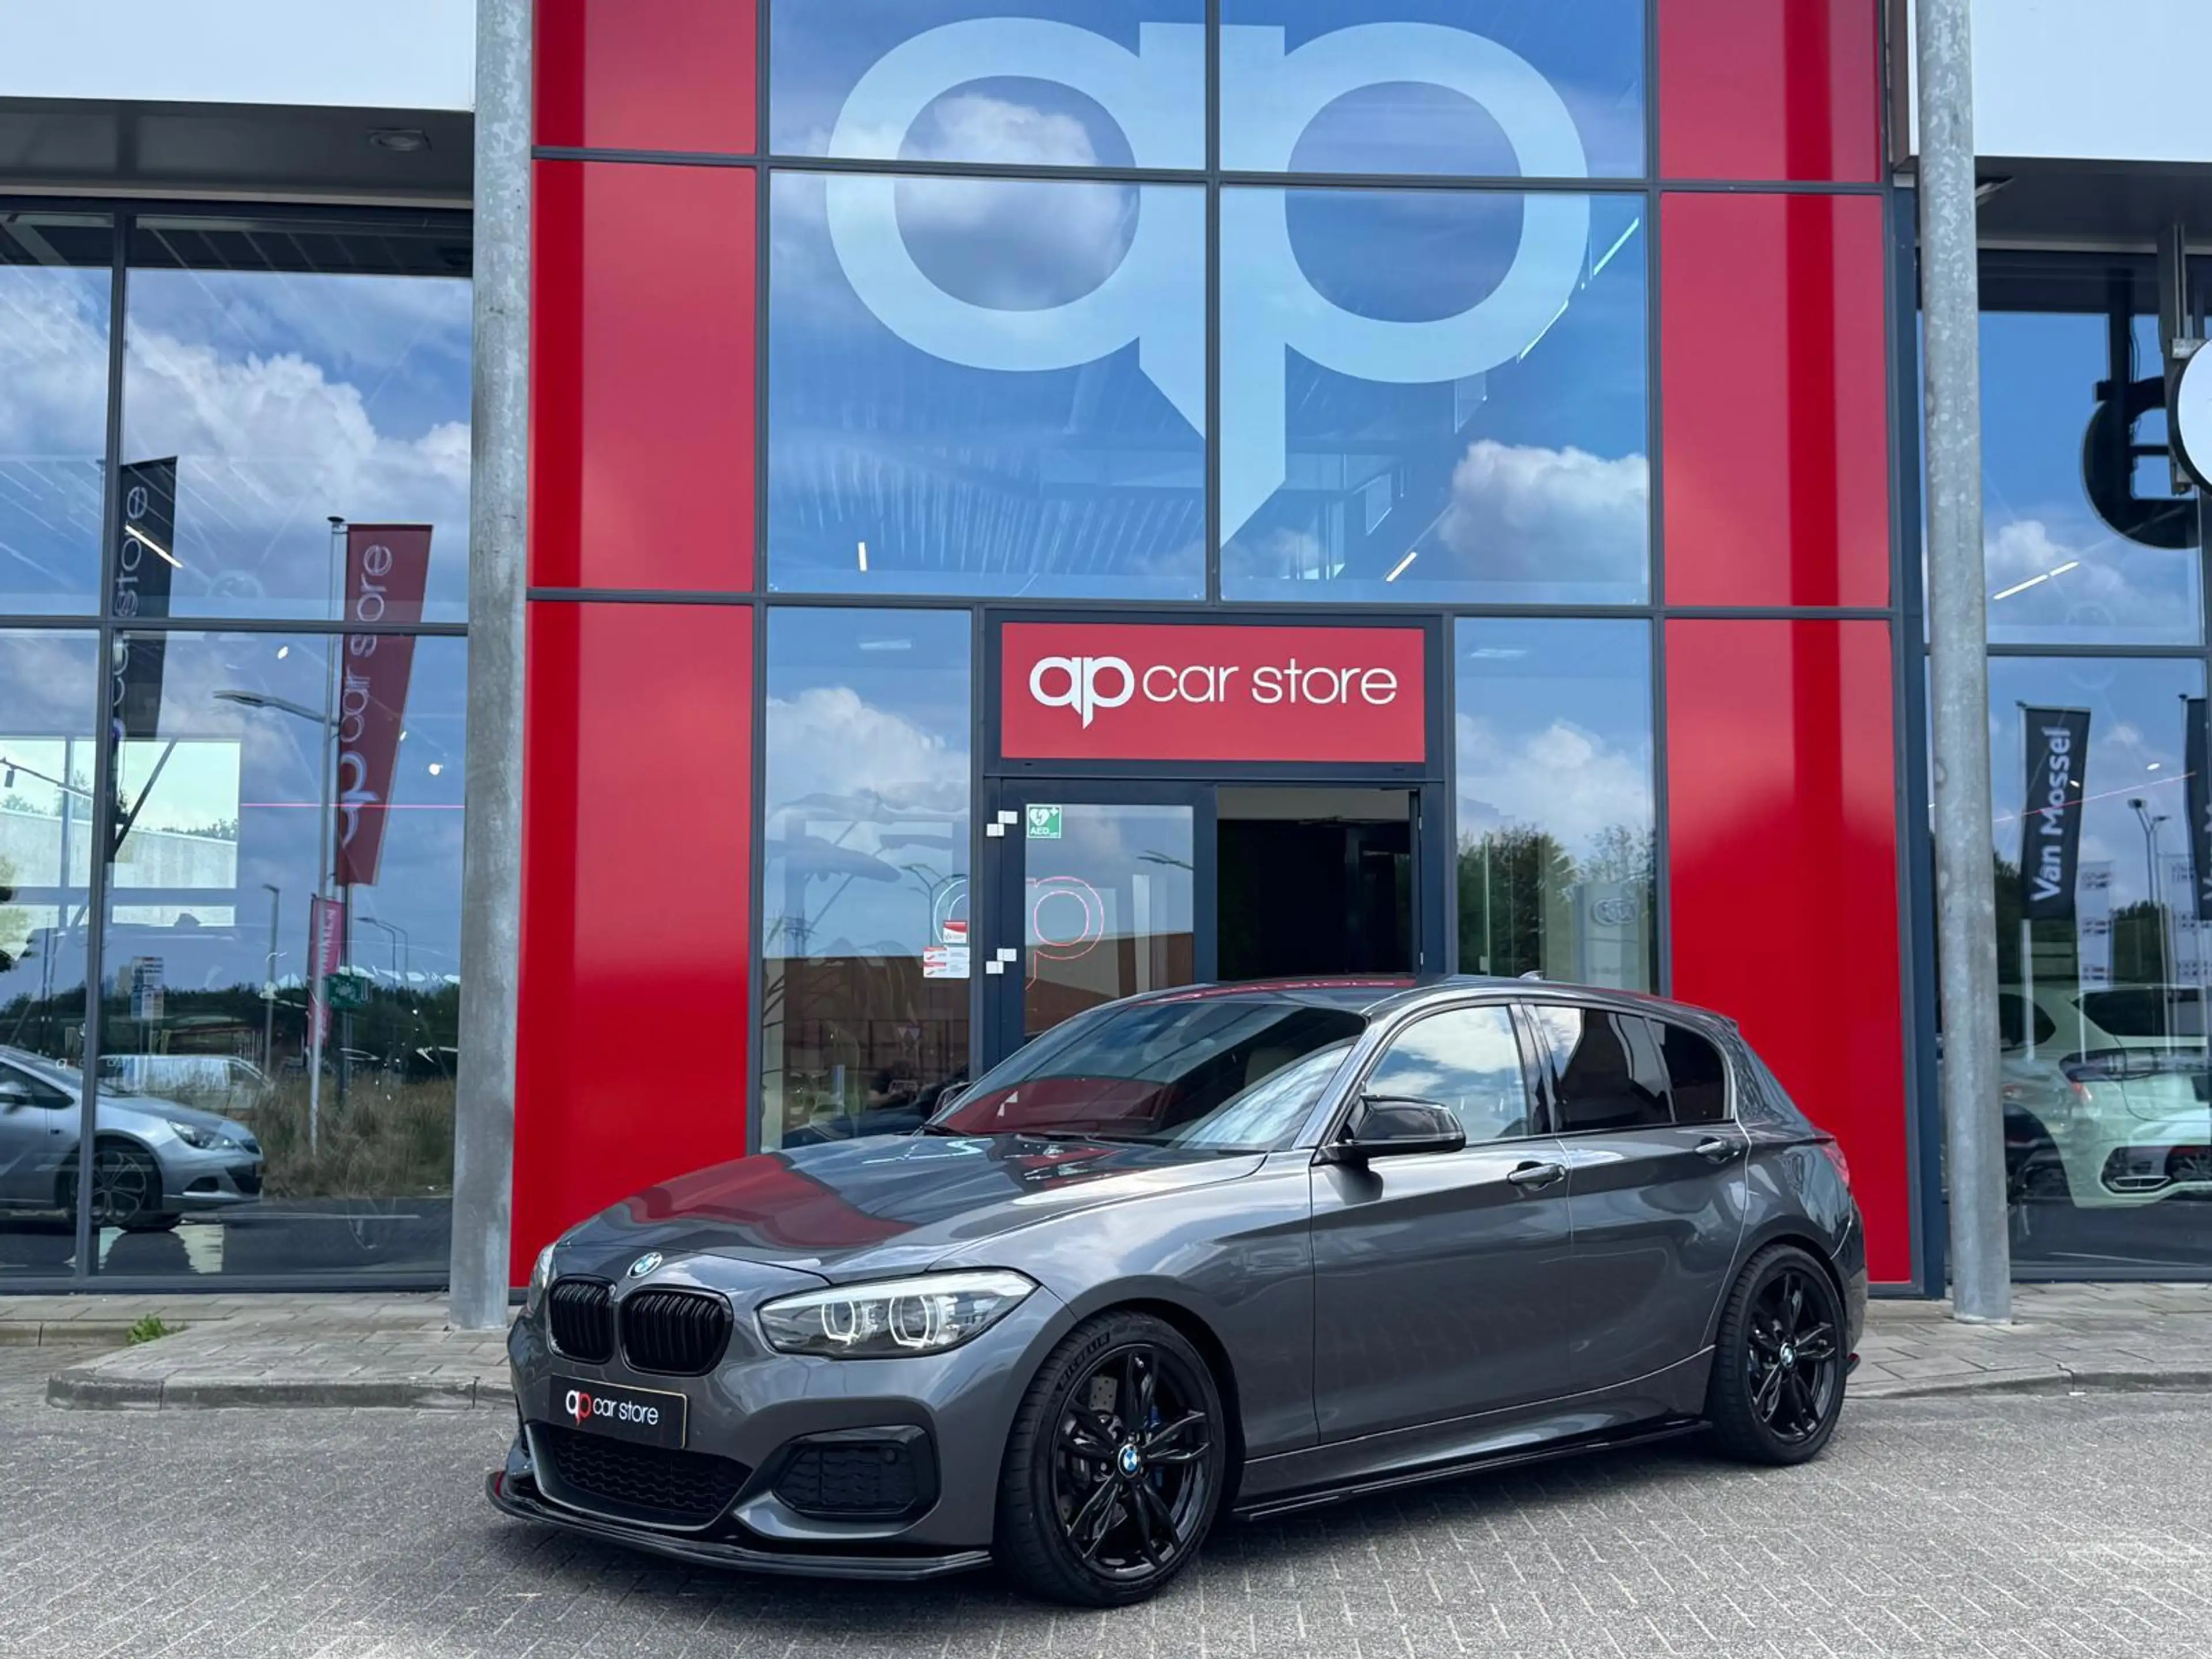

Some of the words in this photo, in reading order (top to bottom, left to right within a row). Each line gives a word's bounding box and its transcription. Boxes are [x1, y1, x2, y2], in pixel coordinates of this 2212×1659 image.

[826, 17, 1590, 548] ap
[350, 544, 392, 657] sore
[340, 665, 370, 743] car
[1029, 656, 1135, 729] ap
[1142, 665, 1239, 702] car
[1251, 658, 1397, 704] store
[2040, 726, 2071, 835] Mossel
[1030, 827, 1050, 835] AED
[2029, 844, 2061, 901] Van
[566, 1389, 592, 1427] ap
[593, 1397, 617, 1417] car
[619, 1400, 659, 1425] store
